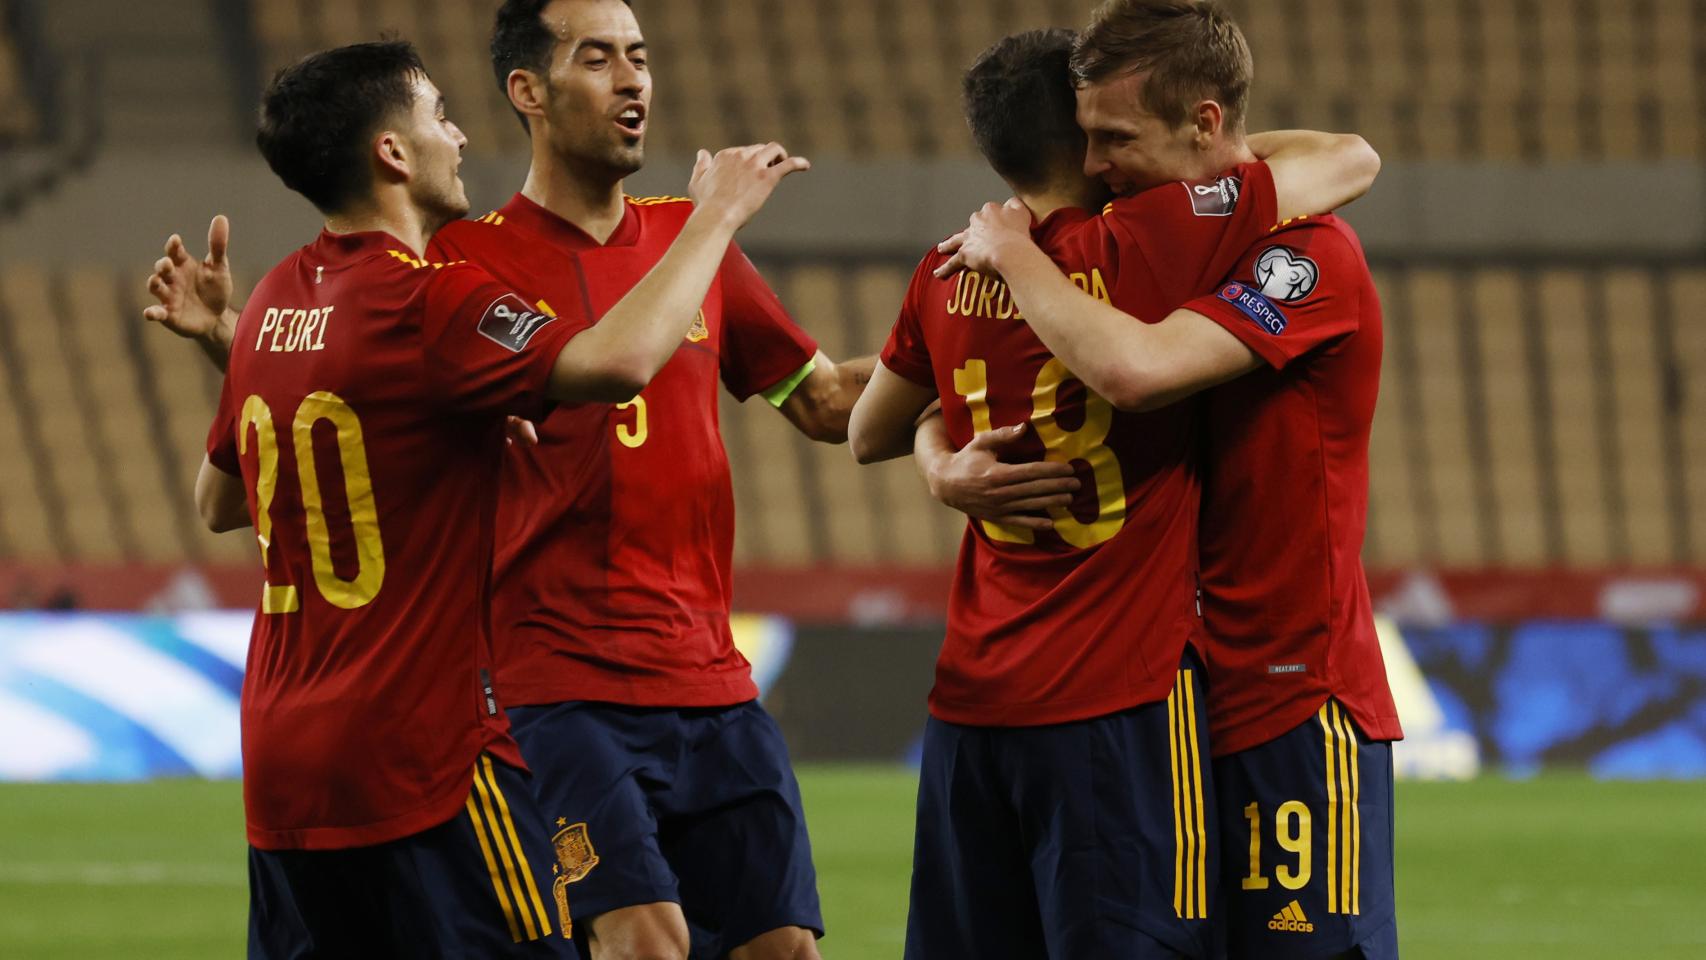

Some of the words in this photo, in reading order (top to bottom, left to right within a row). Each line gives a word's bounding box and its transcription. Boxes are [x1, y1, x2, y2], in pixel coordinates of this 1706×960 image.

[946, 268, 1026, 320] JORD
[1239, 293, 1284, 334] RESPECT
[255, 305, 335, 352] PEDRI
[240, 390, 386, 614] 20
[1241, 800, 1312, 890] 19
[1267, 919, 1314, 933] adidas
